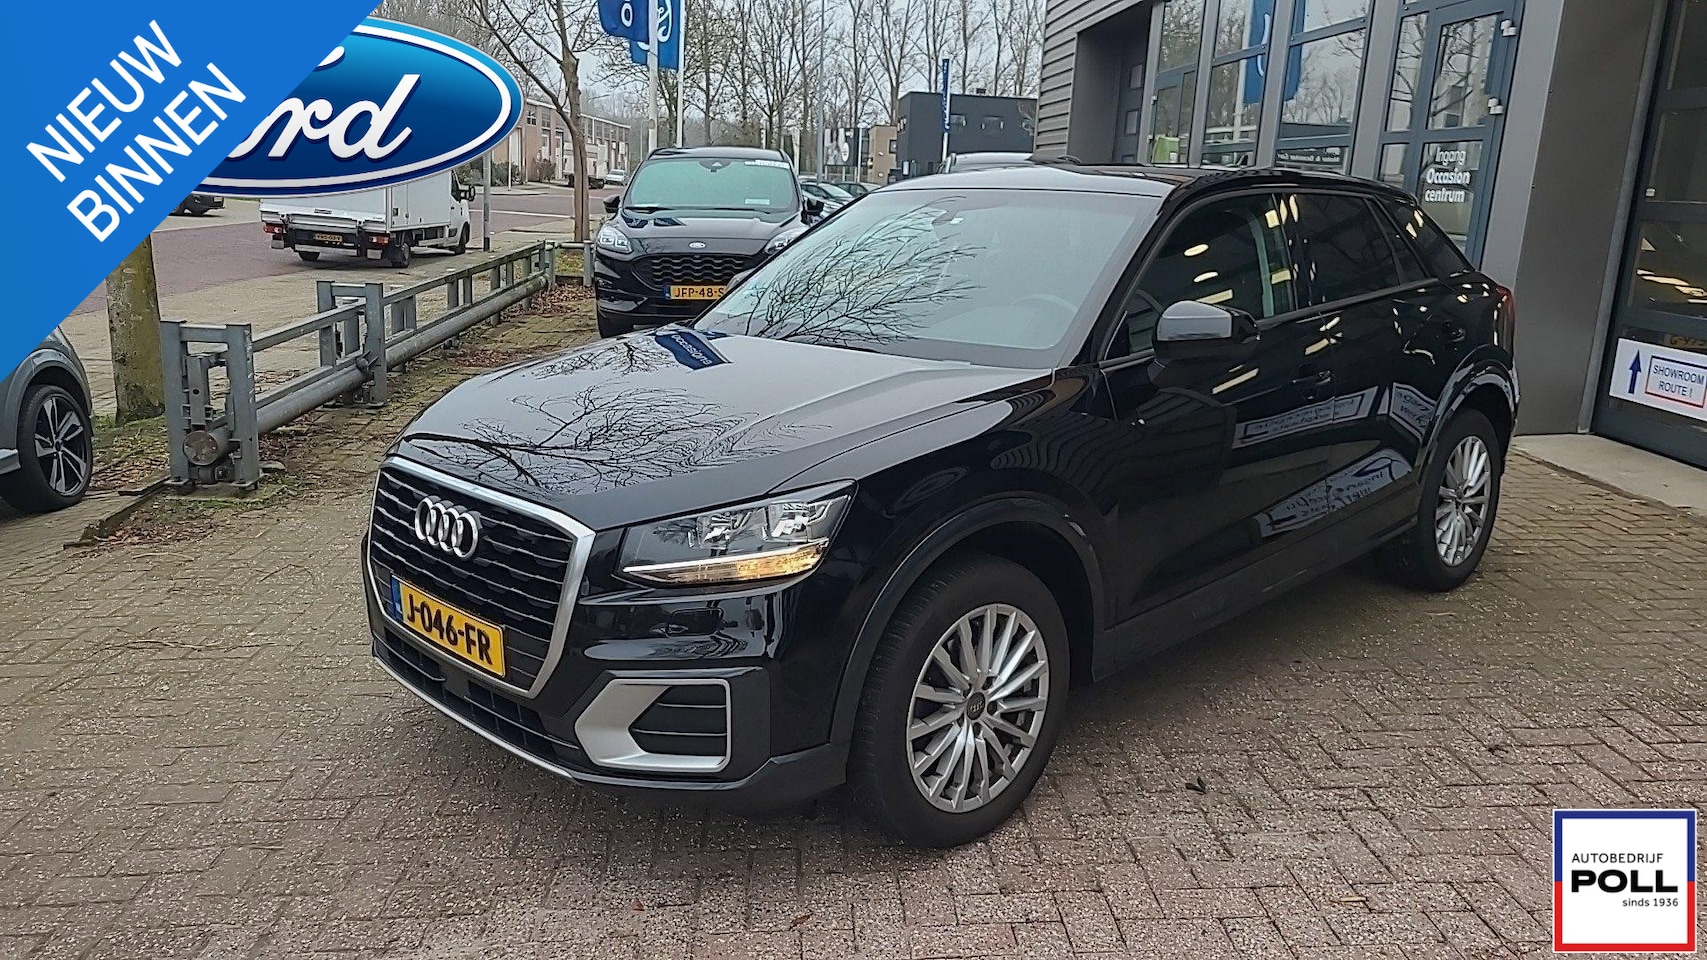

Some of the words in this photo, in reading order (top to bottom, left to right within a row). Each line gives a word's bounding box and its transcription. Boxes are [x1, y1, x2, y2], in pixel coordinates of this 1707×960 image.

[1435, 146, 1466, 166] Ingang
[1426, 168, 1471, 185] Occasion
[1425, 187, 1466, 203] centrum
[1653, 364, 1705, 385] SHOWROOM
[1659, 380, 1688, 397] ROUTE
[407, 593, 493, 666] J-046-FR
